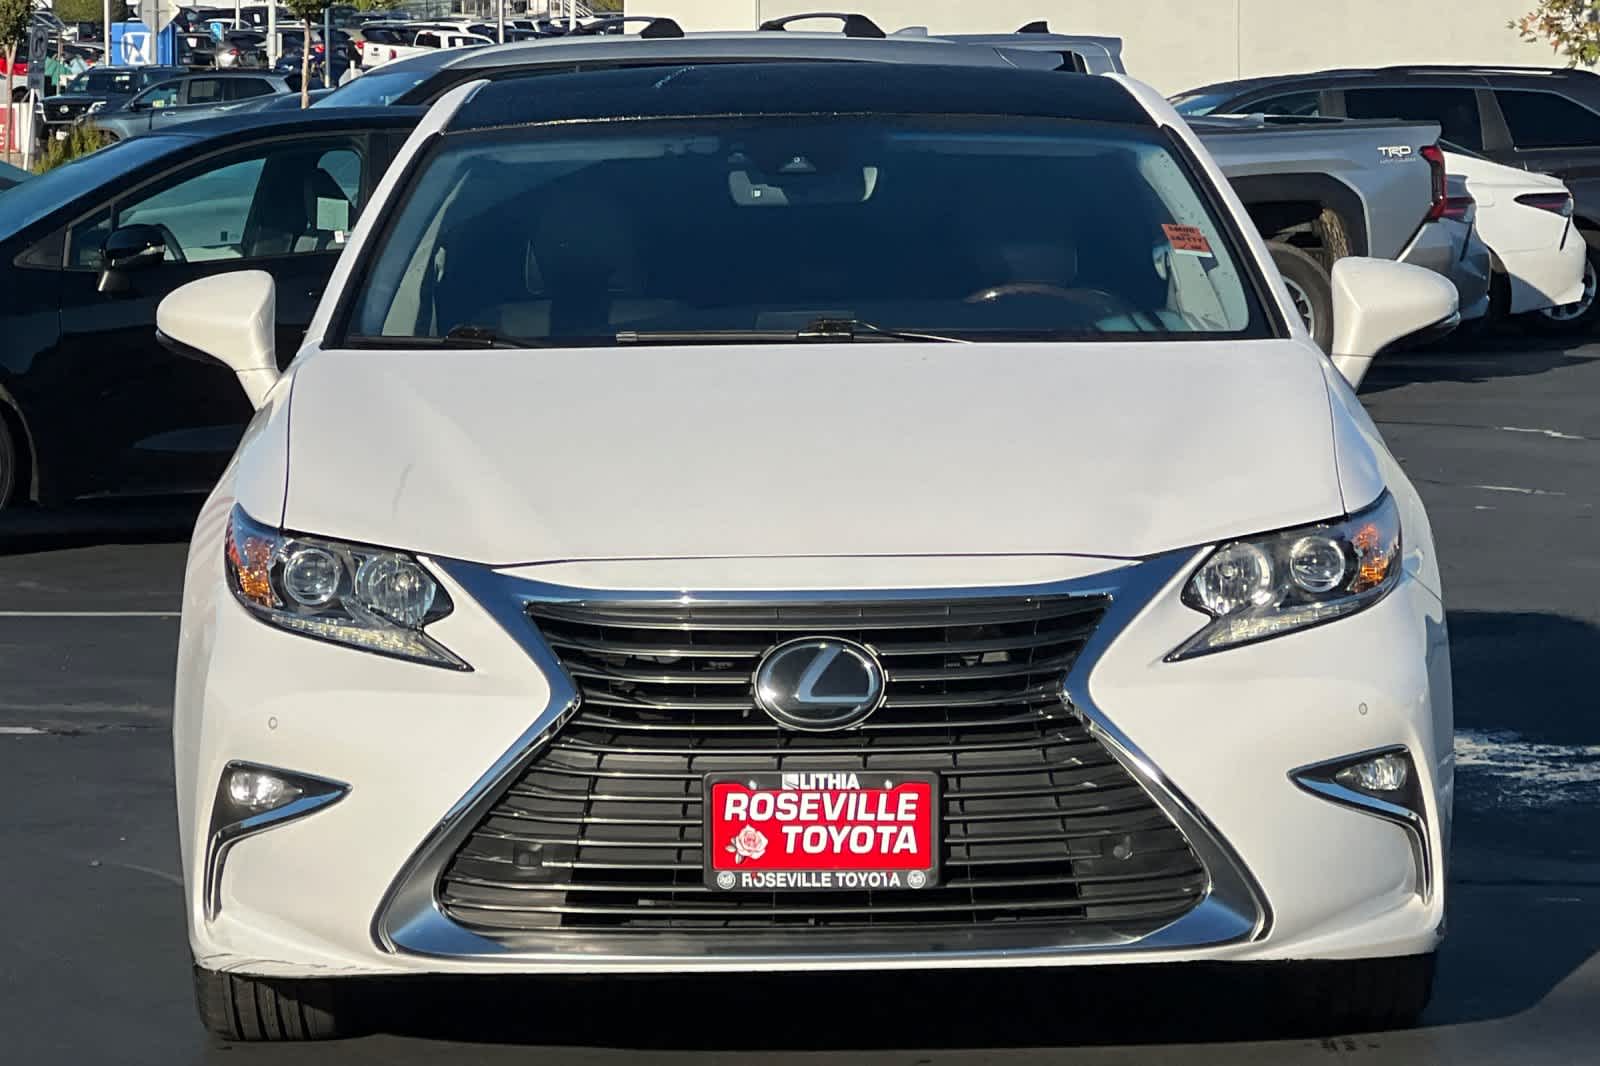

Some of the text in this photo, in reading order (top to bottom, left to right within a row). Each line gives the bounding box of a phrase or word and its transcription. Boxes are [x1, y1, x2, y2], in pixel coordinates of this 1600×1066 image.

[1377, 146, 1411, 157] TRD
[800, 773, 861, 790] LITHIA
[724, 792, 919, 821] ROSEVILLE
[781, 825, 918, 854] TOYOTA
[741, 871, 832, 888] ROSEVILLE
[835, 871, 901, 888] TOYOTA
